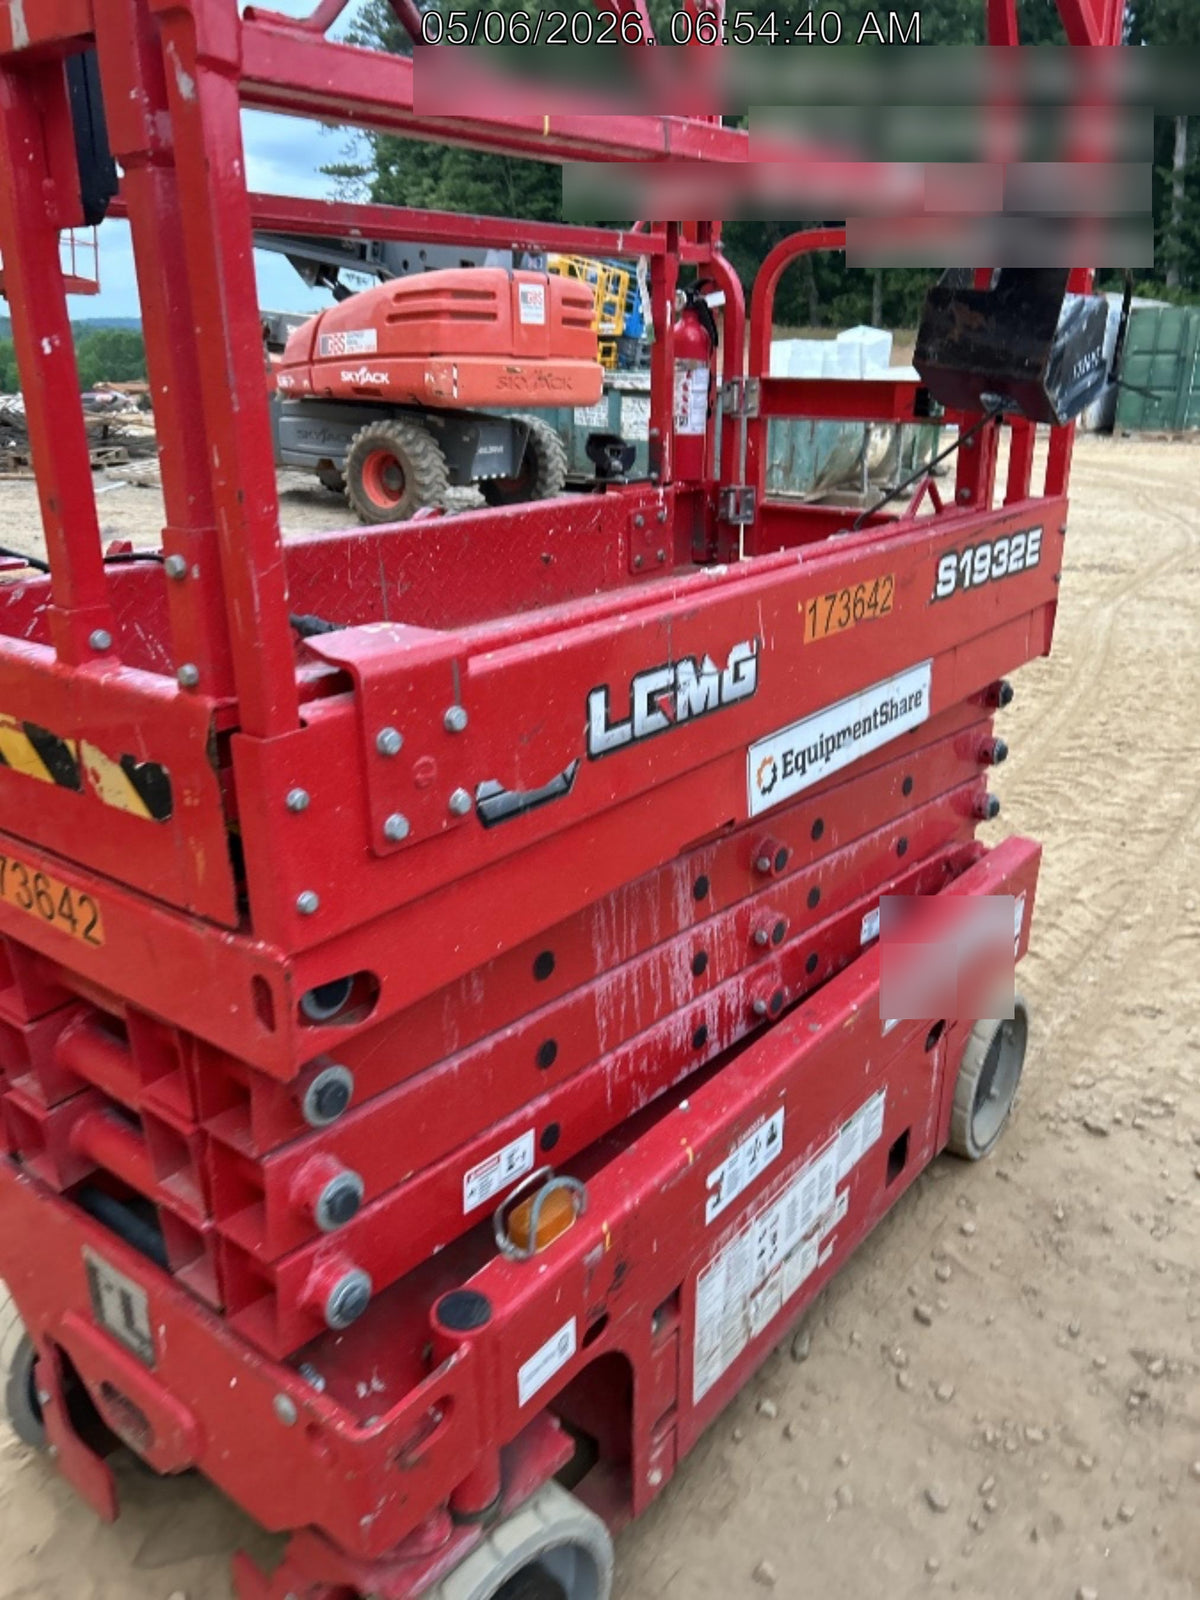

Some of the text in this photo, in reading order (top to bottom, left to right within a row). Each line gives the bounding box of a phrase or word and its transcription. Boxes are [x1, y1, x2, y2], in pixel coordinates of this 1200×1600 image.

[340, 366, 390, 385] SKYJACK
[935, 525, 1044, 599] S1932E
[808, 574, 893, 638] 173642
[781, 688, 923, 780] EquipmentShare
